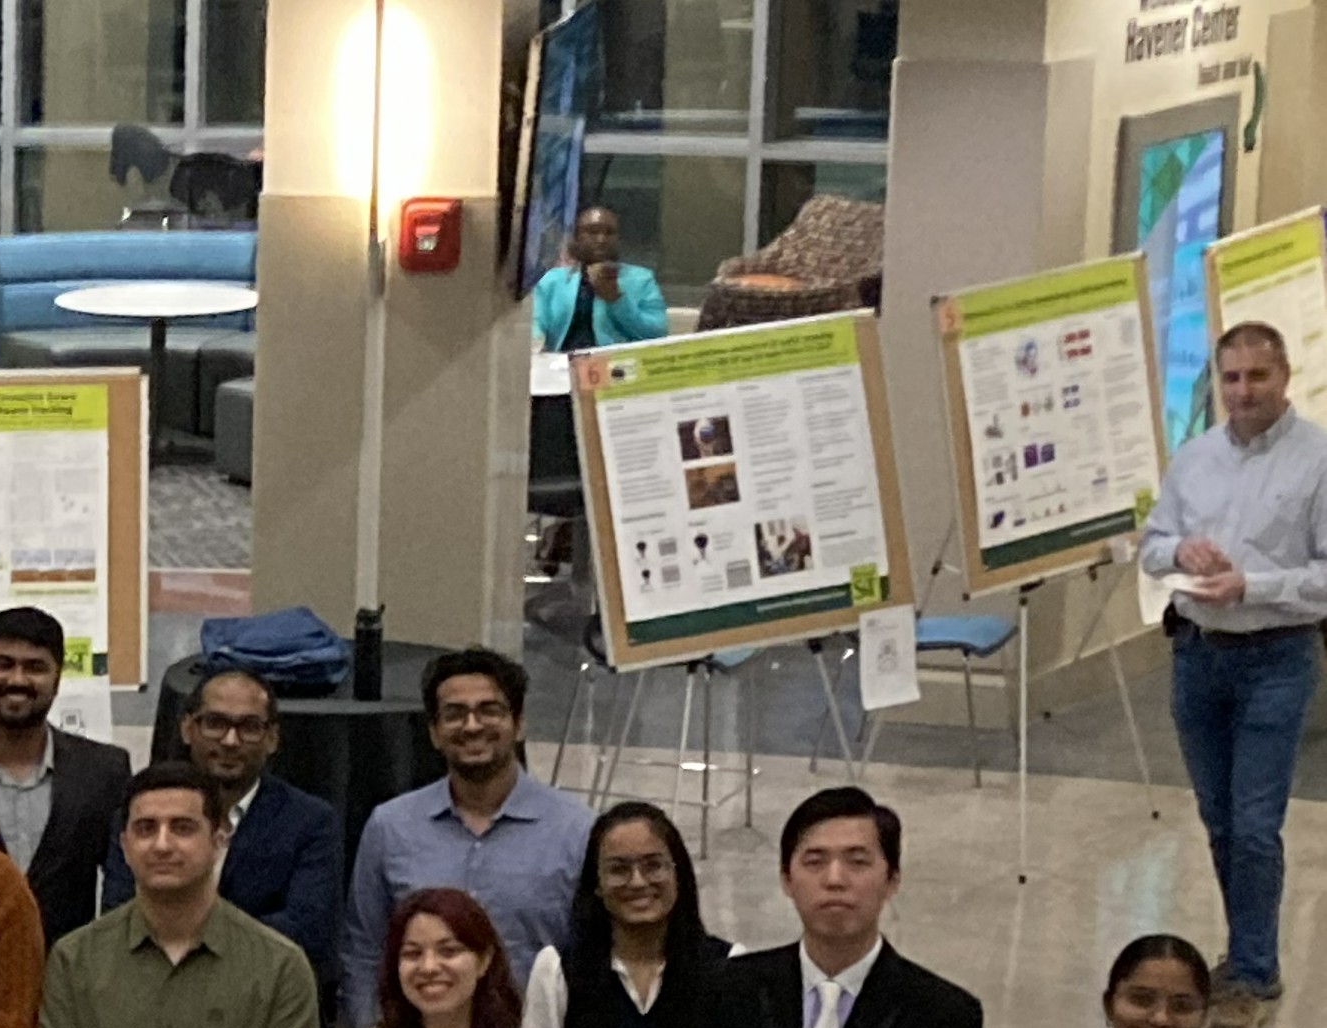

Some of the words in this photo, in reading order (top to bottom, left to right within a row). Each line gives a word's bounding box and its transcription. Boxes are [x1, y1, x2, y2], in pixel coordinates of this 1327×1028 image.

[1125, 17, 1188, 63] Havener
[1191, 4, 1240, 49] Center
[587, 363, 600, 386] 6
